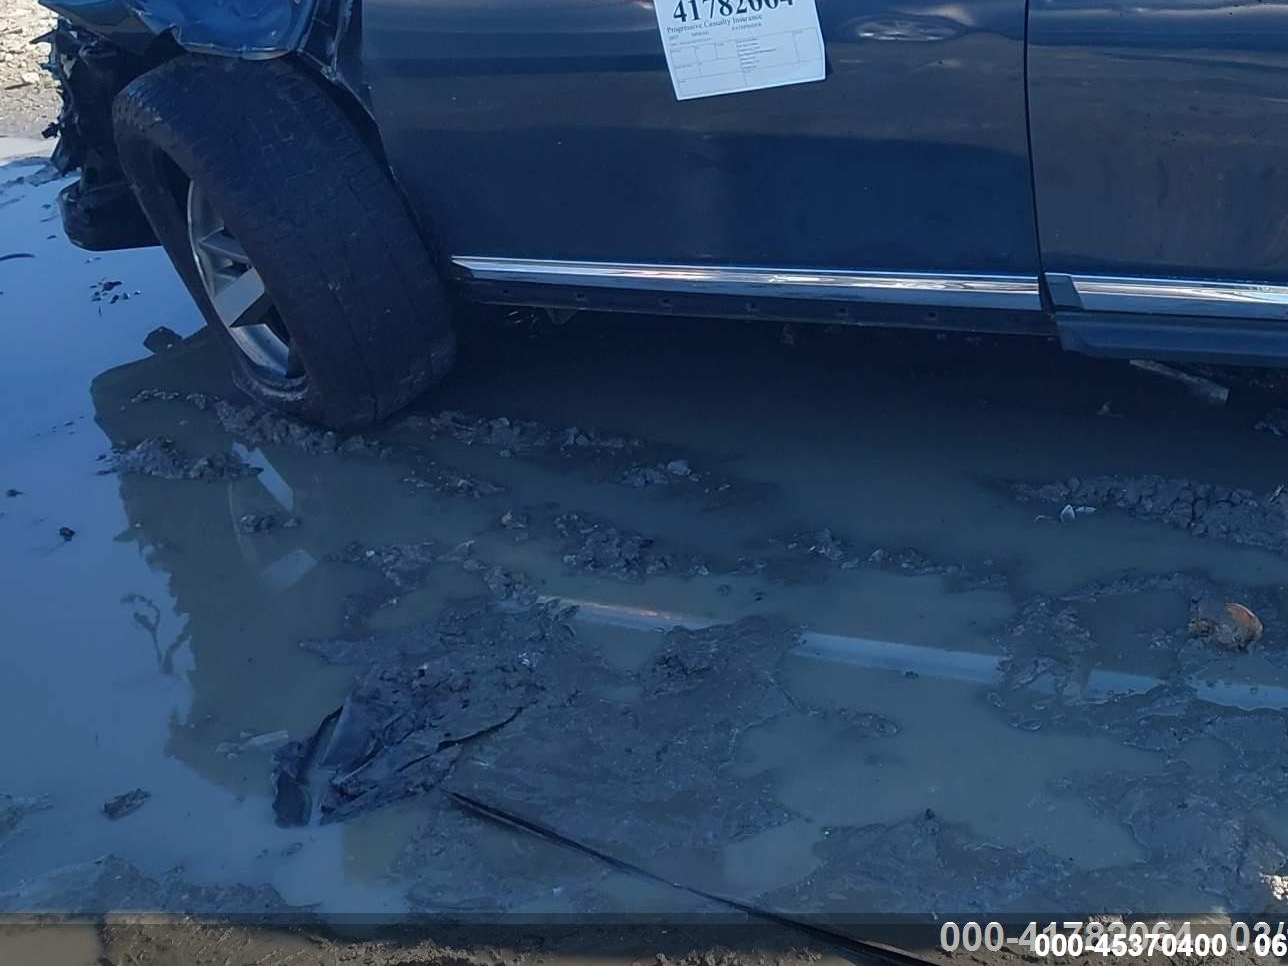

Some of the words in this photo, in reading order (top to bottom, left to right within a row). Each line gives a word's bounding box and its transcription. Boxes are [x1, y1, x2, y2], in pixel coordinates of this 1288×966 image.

[666, 23, 703, 34] Progressive
[704, 17, 731, 28] Casualty
[732, 14, 763, 24] Insurance
